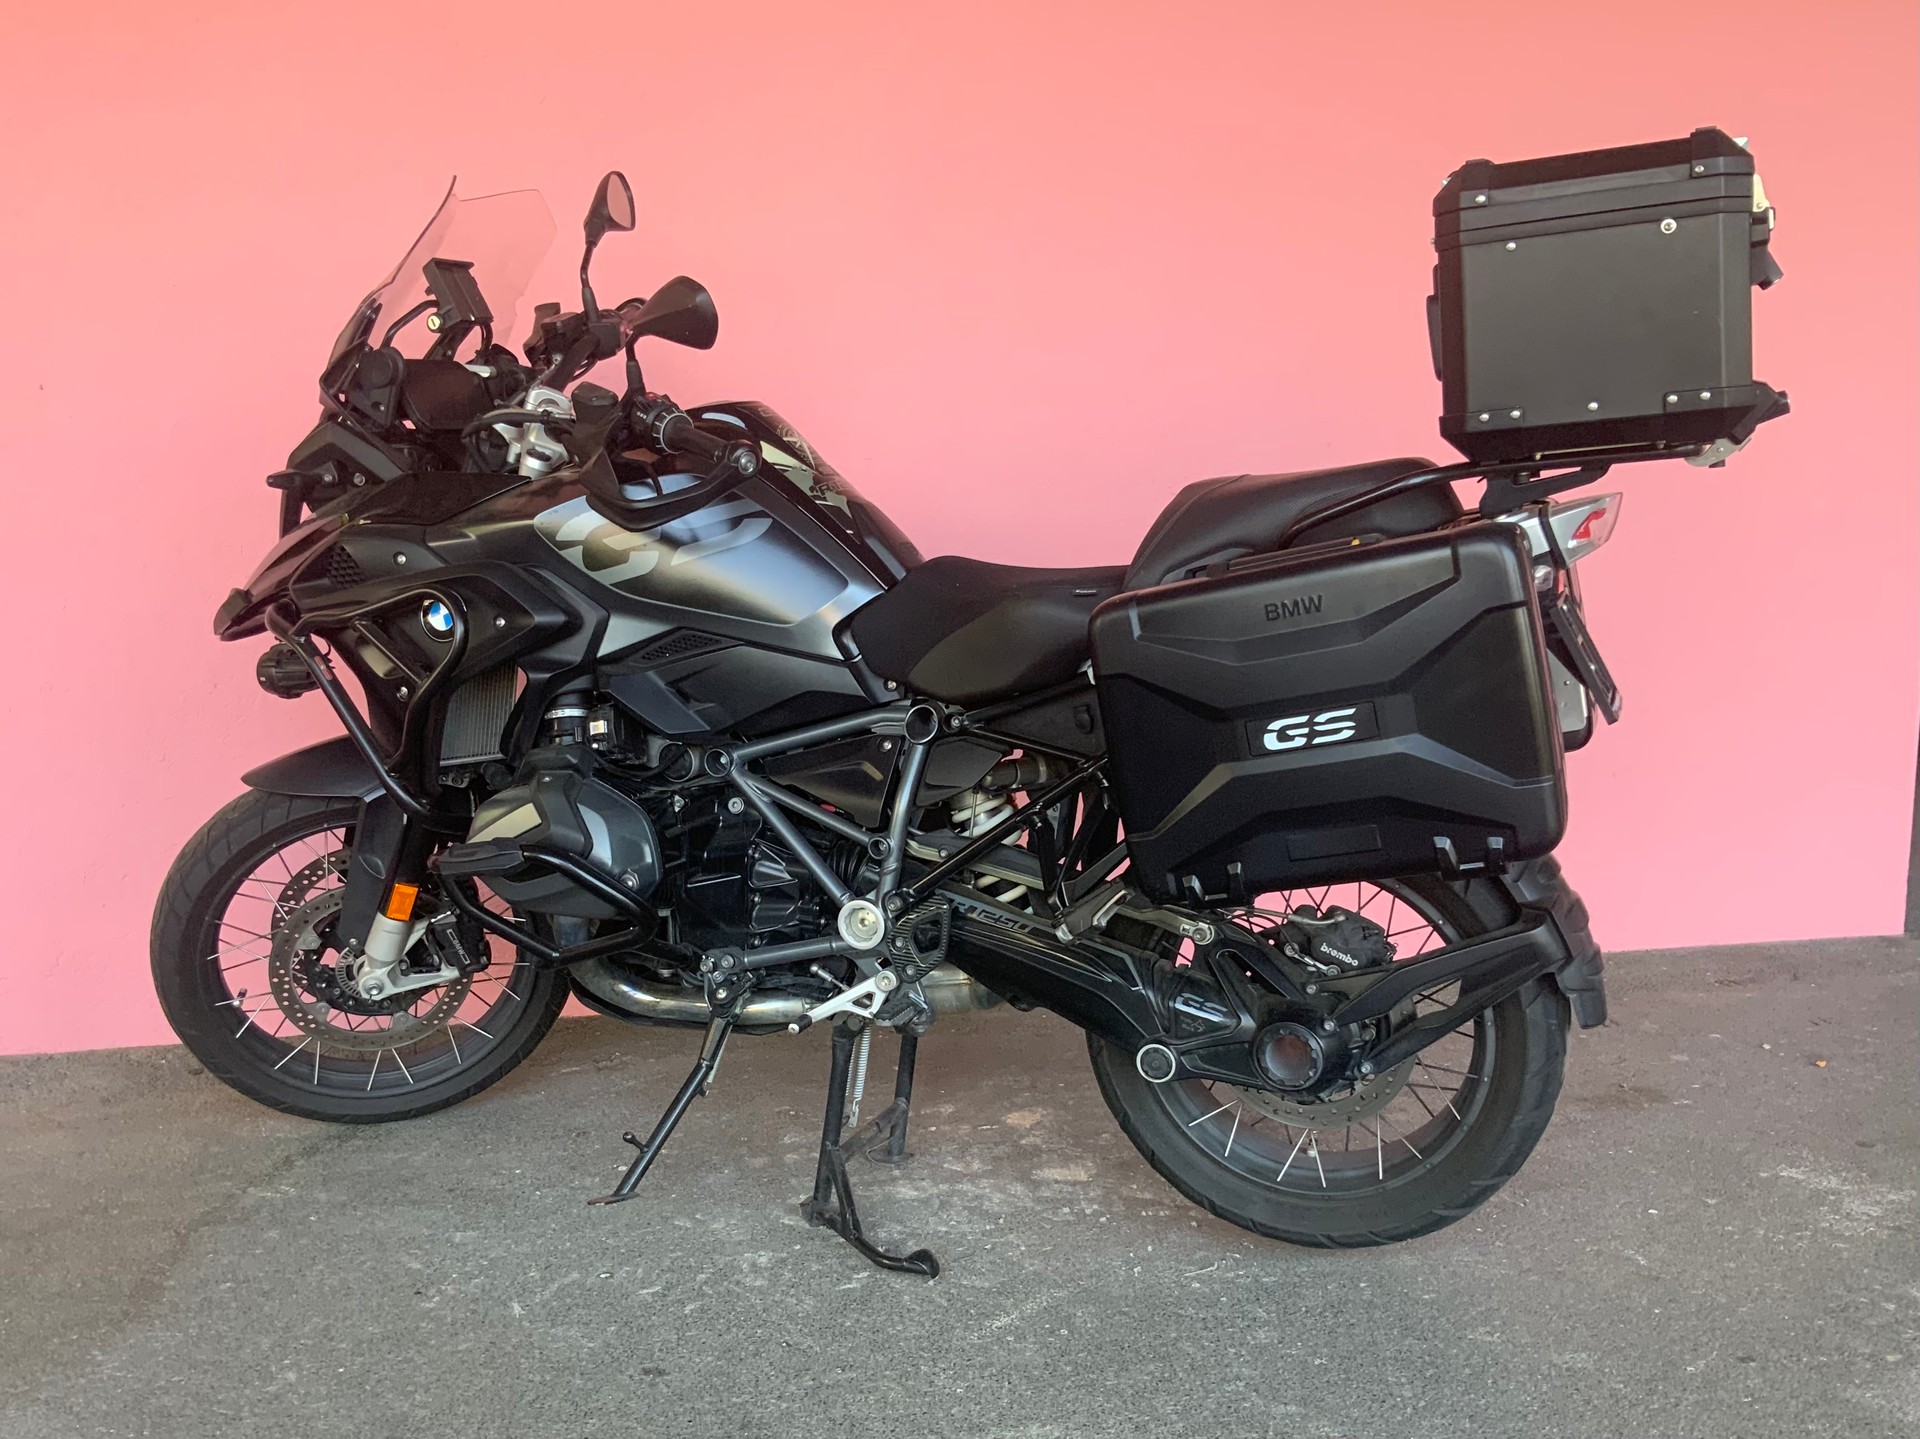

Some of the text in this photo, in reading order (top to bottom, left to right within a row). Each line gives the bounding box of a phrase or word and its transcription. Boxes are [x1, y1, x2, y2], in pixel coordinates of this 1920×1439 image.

[1264, 594, 1323, 621] BMW
[1263, 707, 1357, 751] GS
[452, 938, 467, 956] BMW
[1320, 942, 1359, 967] brembo
[1174, 992, 1229, 1022] GS
